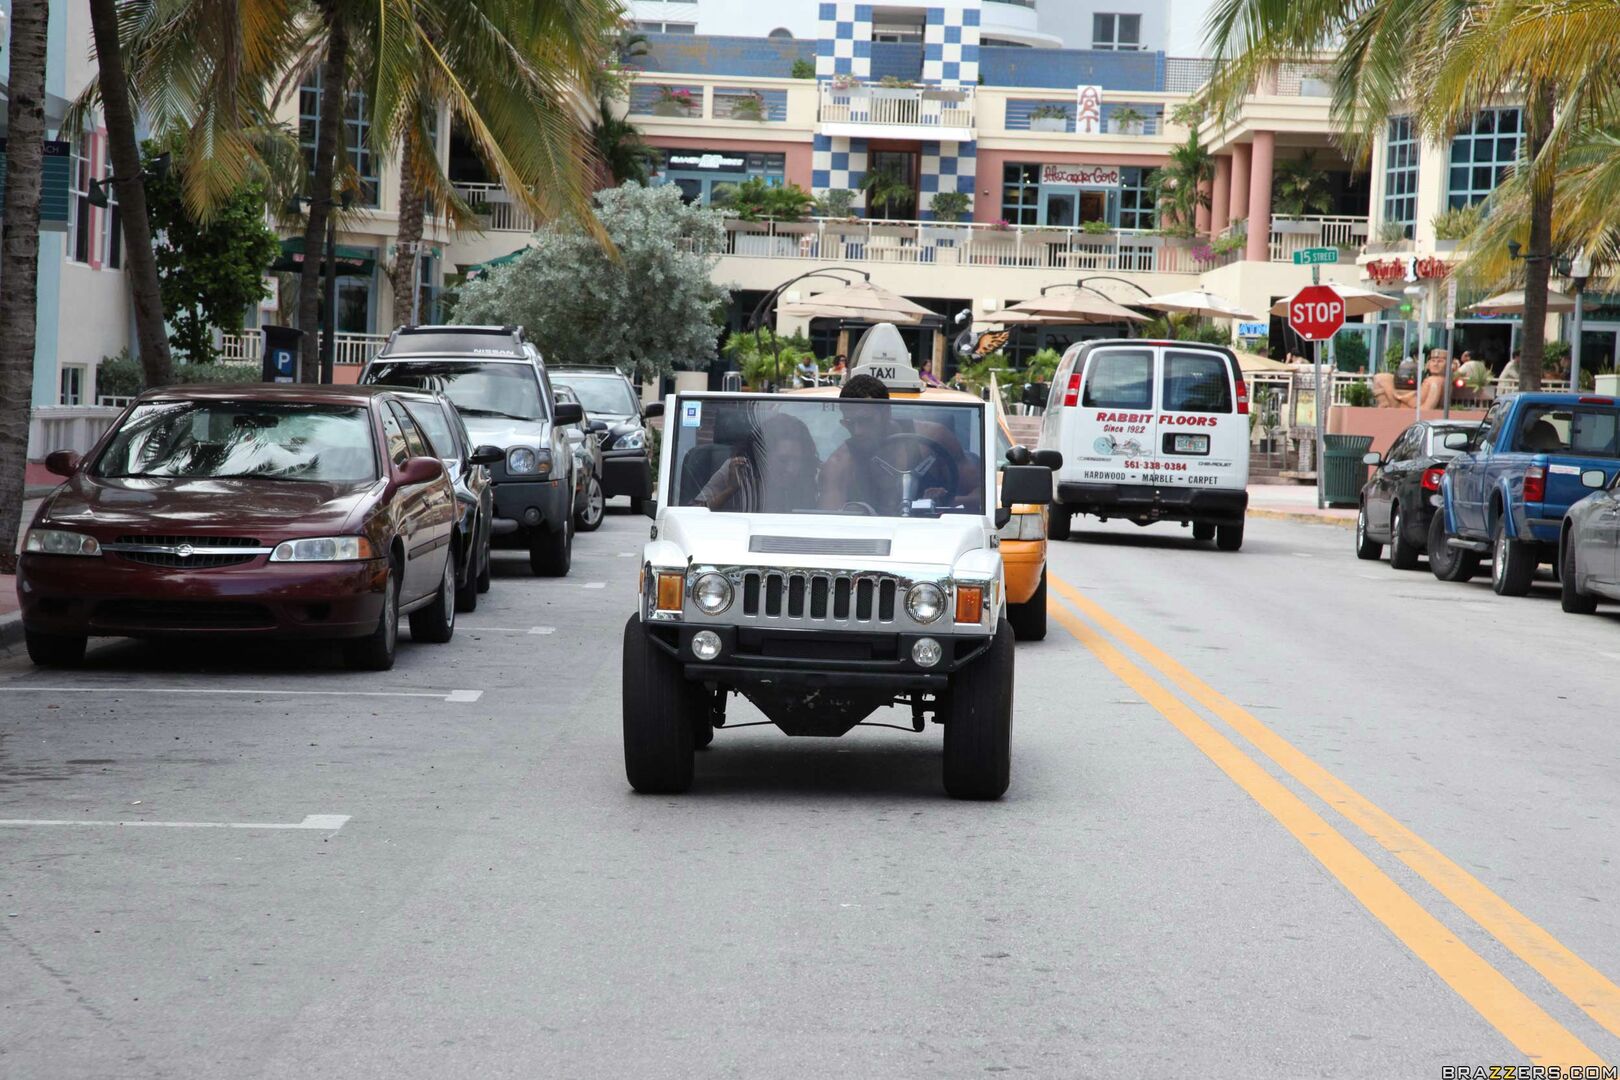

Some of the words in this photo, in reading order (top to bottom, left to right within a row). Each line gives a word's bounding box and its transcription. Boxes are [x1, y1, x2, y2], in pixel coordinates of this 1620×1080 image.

[1079, 86, 1100, 133] ART
[1300, 251, 1311, 264] 15
[1312, 252, 1335, 262] STREET
[1293, 302, 1341, 324] STOP
[278, 351, 290, 370] P
[869, 367, 895, 379] TAXI
[1096, 412, 1154, 424] RABBIT
[1158, 415, 1218, 427] FLOORS
[1103, 424, 1124, 433] Since
[1124, 460, 1187, 471] 561-338-0384
[1084, 470, 1126, 481] HARDWOOD
[1142, 474, 1174, 483] MARBLE
[1188, 476, 1218, 485] CARPET
